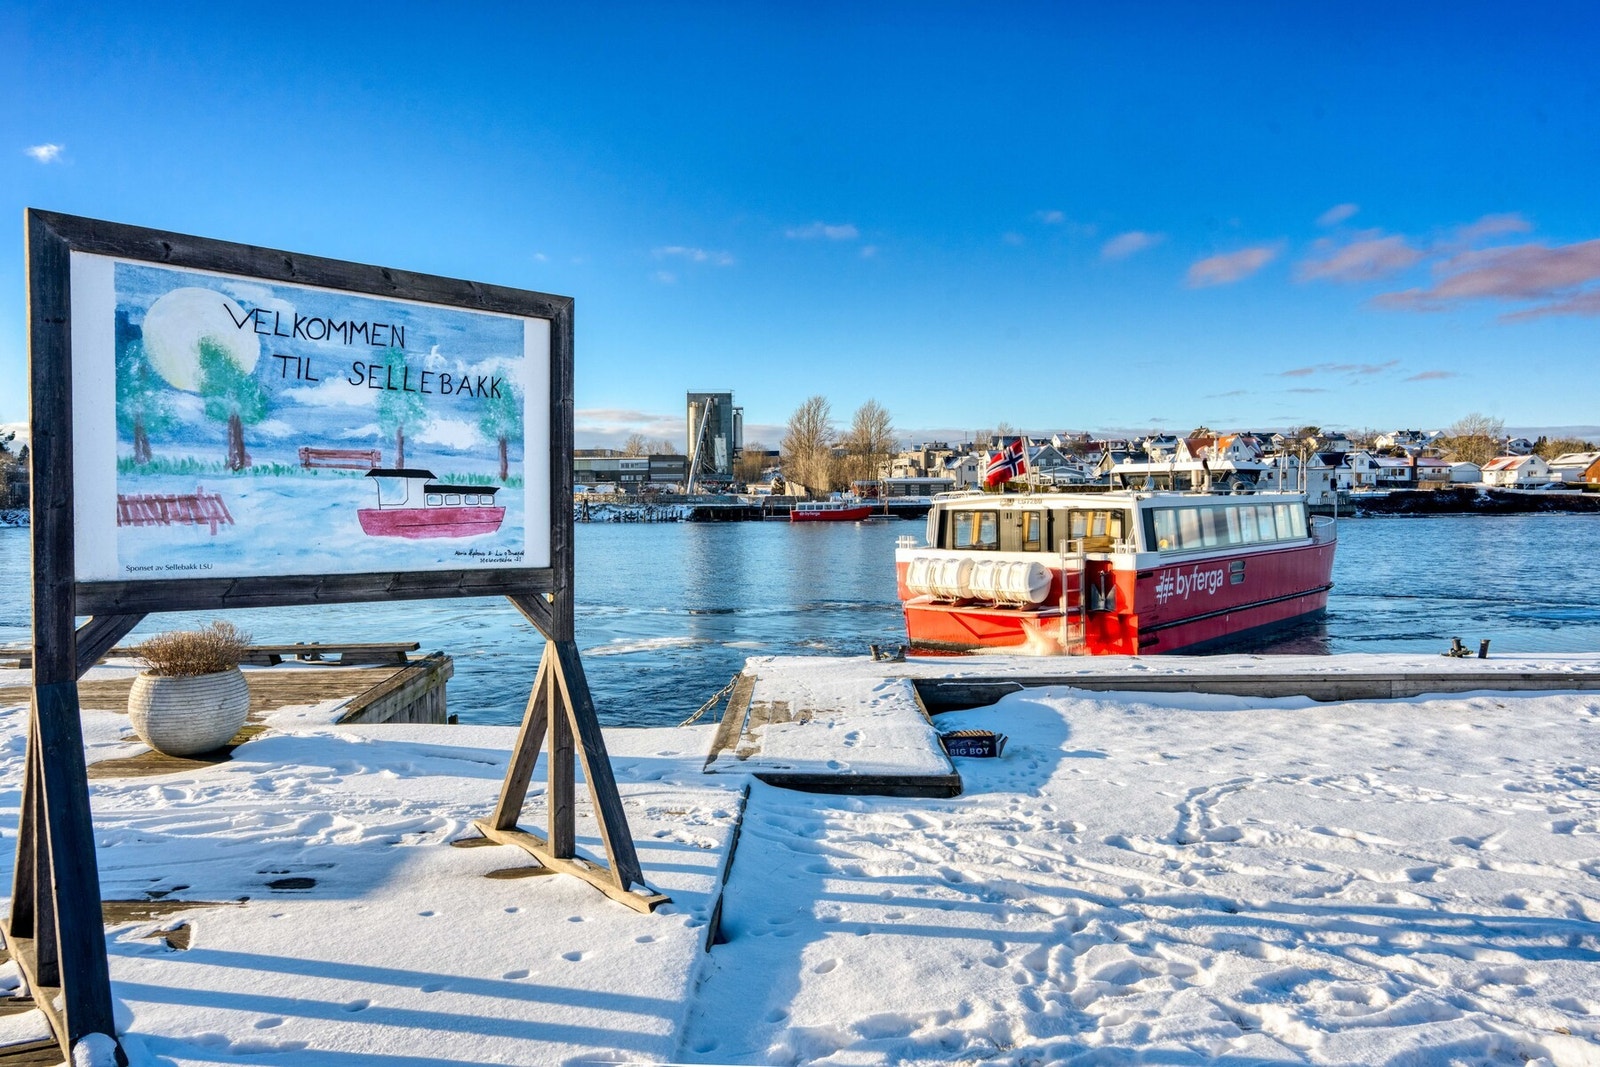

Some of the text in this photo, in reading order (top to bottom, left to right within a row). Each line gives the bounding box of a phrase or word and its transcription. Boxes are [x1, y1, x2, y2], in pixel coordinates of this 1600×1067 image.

[223, 303, 405, 349] VELKOMMEN
[272, 354, 502, 399] TIL SELLEBAKK
[126, 564, 154, 573] Sponset
[165, 563, 198, 571] Sellebakk
[1176, 565, 1223, 600] byferga
[950, 747, 989, 756] BIG BOY
